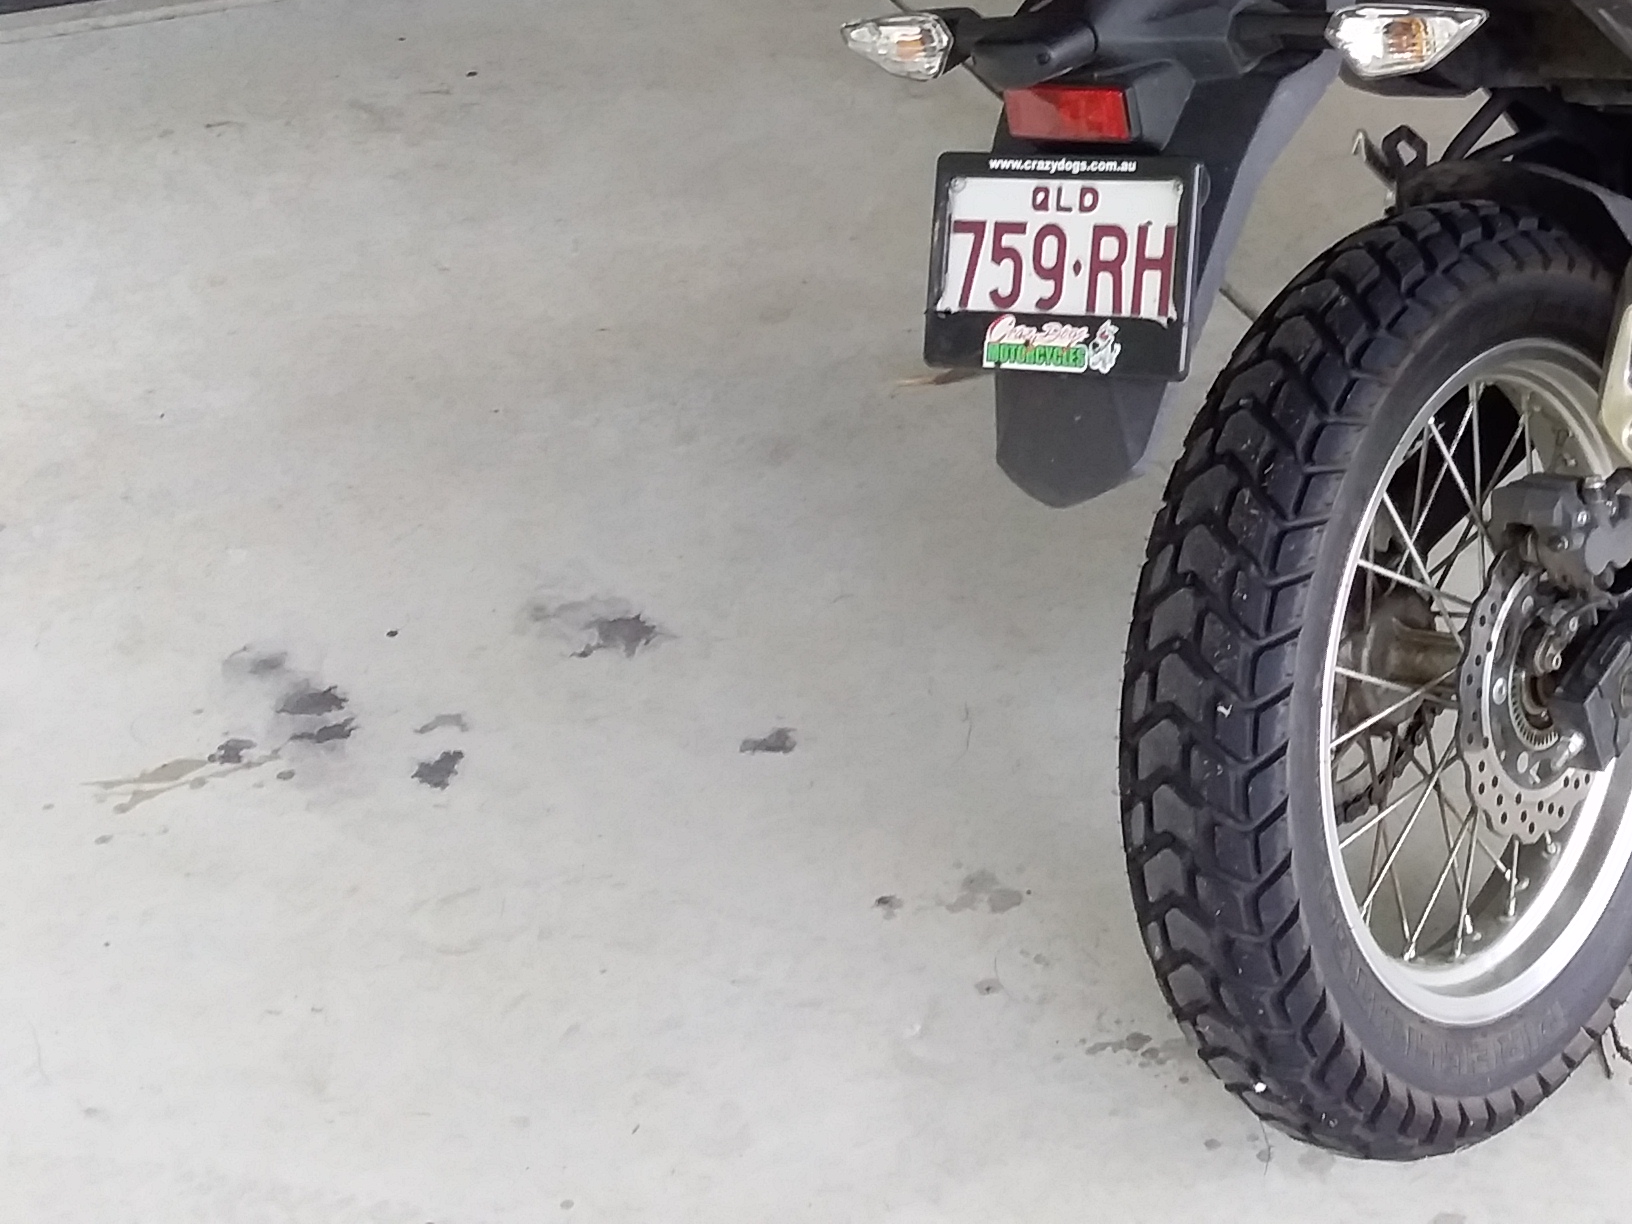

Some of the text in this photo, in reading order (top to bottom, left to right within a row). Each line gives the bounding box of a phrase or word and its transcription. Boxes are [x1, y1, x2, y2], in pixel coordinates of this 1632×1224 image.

[988, 157, 1137, 174] www.crazydogs.com.au
[1032, 186, 1099, 212] QLD
[986, 342, 1086, 368] MOTORCYCLES
